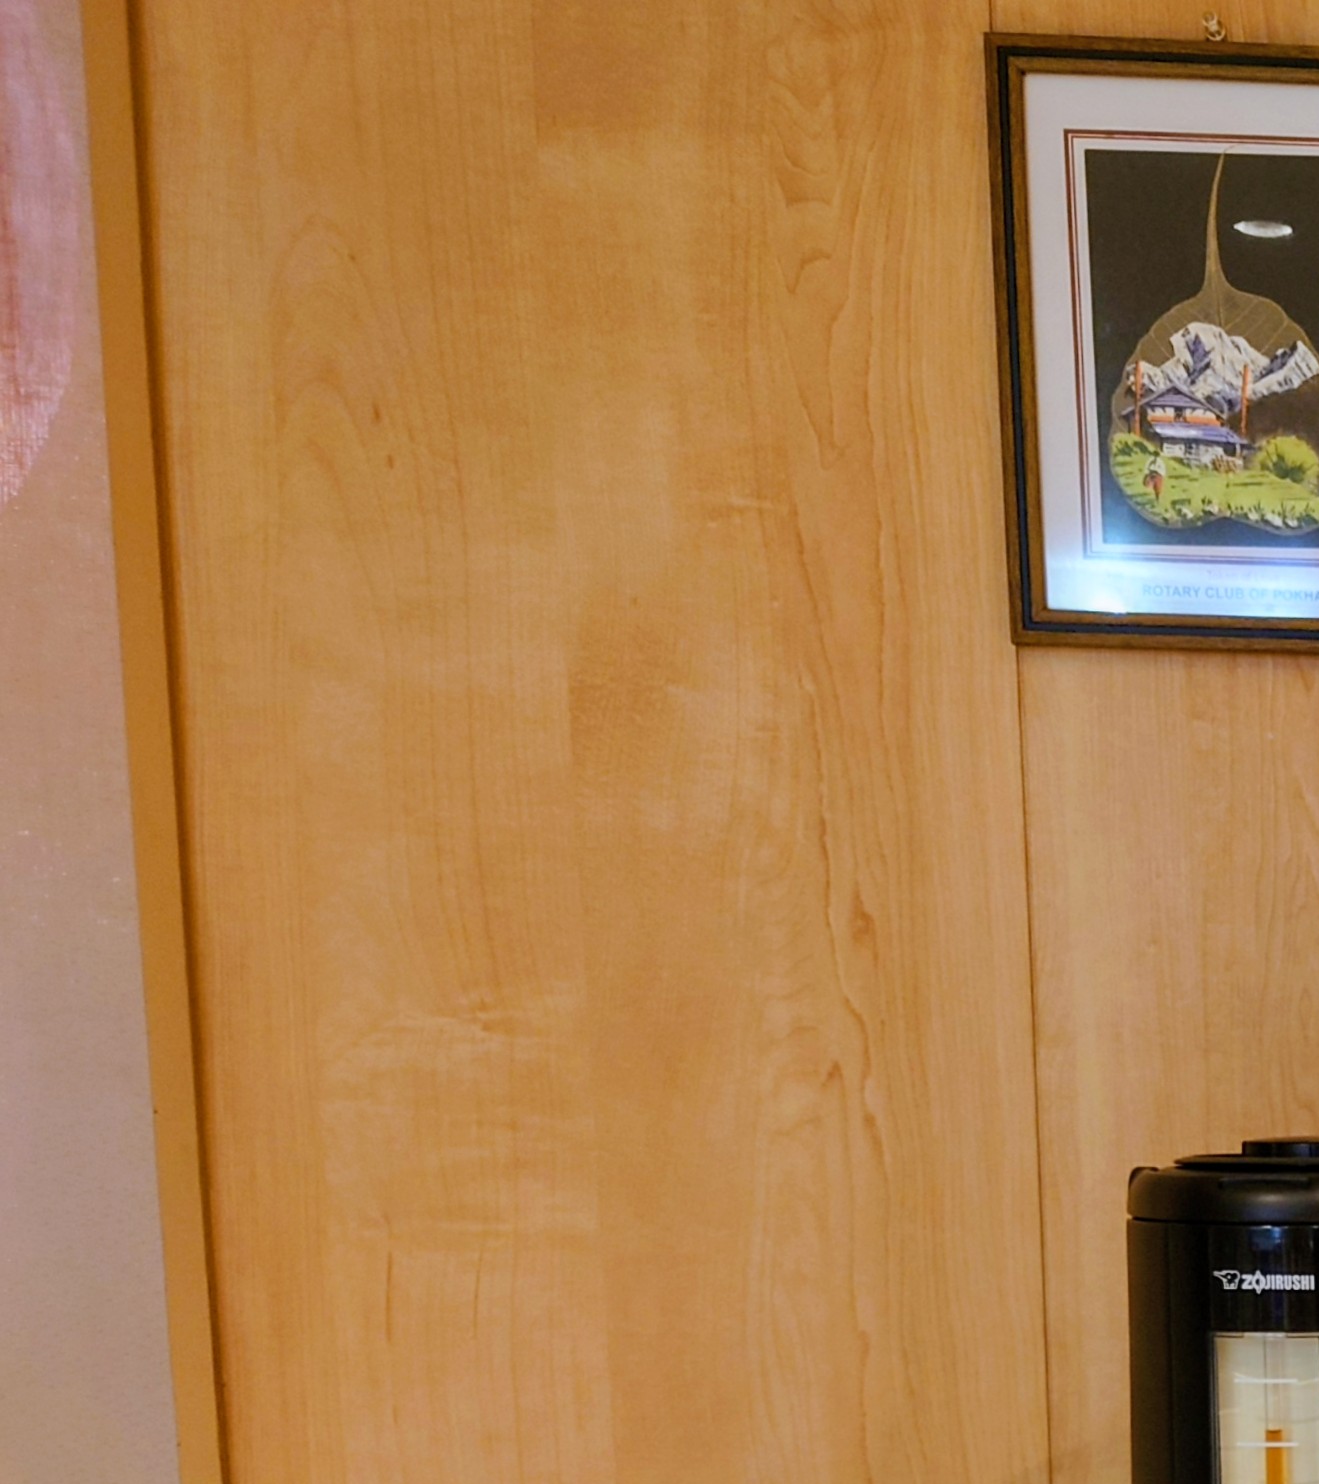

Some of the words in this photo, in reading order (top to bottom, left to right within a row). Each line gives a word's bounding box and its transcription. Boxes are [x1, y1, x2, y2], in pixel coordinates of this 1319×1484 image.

[1143, 584, 1201, 599] ROTARY
[1205, 586, 1245, 600] CLUB
[1249, 587, 1268, 600] OF
[1241, 1270, 1315, 1294] ZOJIRUSHI
